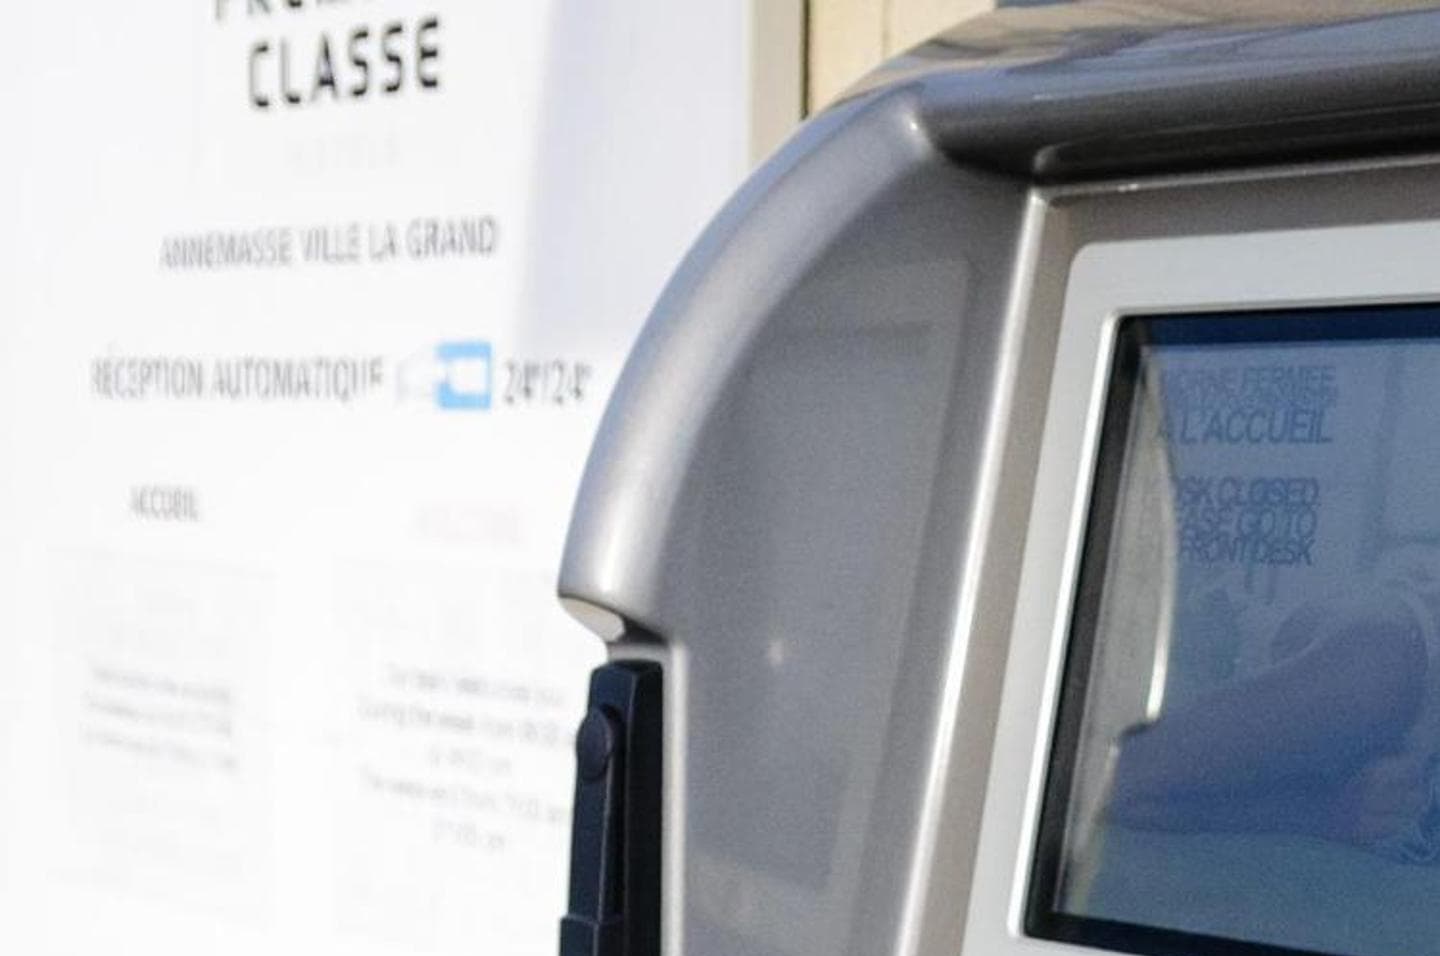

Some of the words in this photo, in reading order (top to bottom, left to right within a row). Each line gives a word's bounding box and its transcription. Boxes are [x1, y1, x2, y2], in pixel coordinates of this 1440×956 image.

[246, 14, 441, 111] CLASSE
[159, 226, 292, 269] ANNEMASSE
[302, 222, 362, 264] VILLE
[368, 221, 399, 261] LA
[405, 215, 498, 259] GRAND
